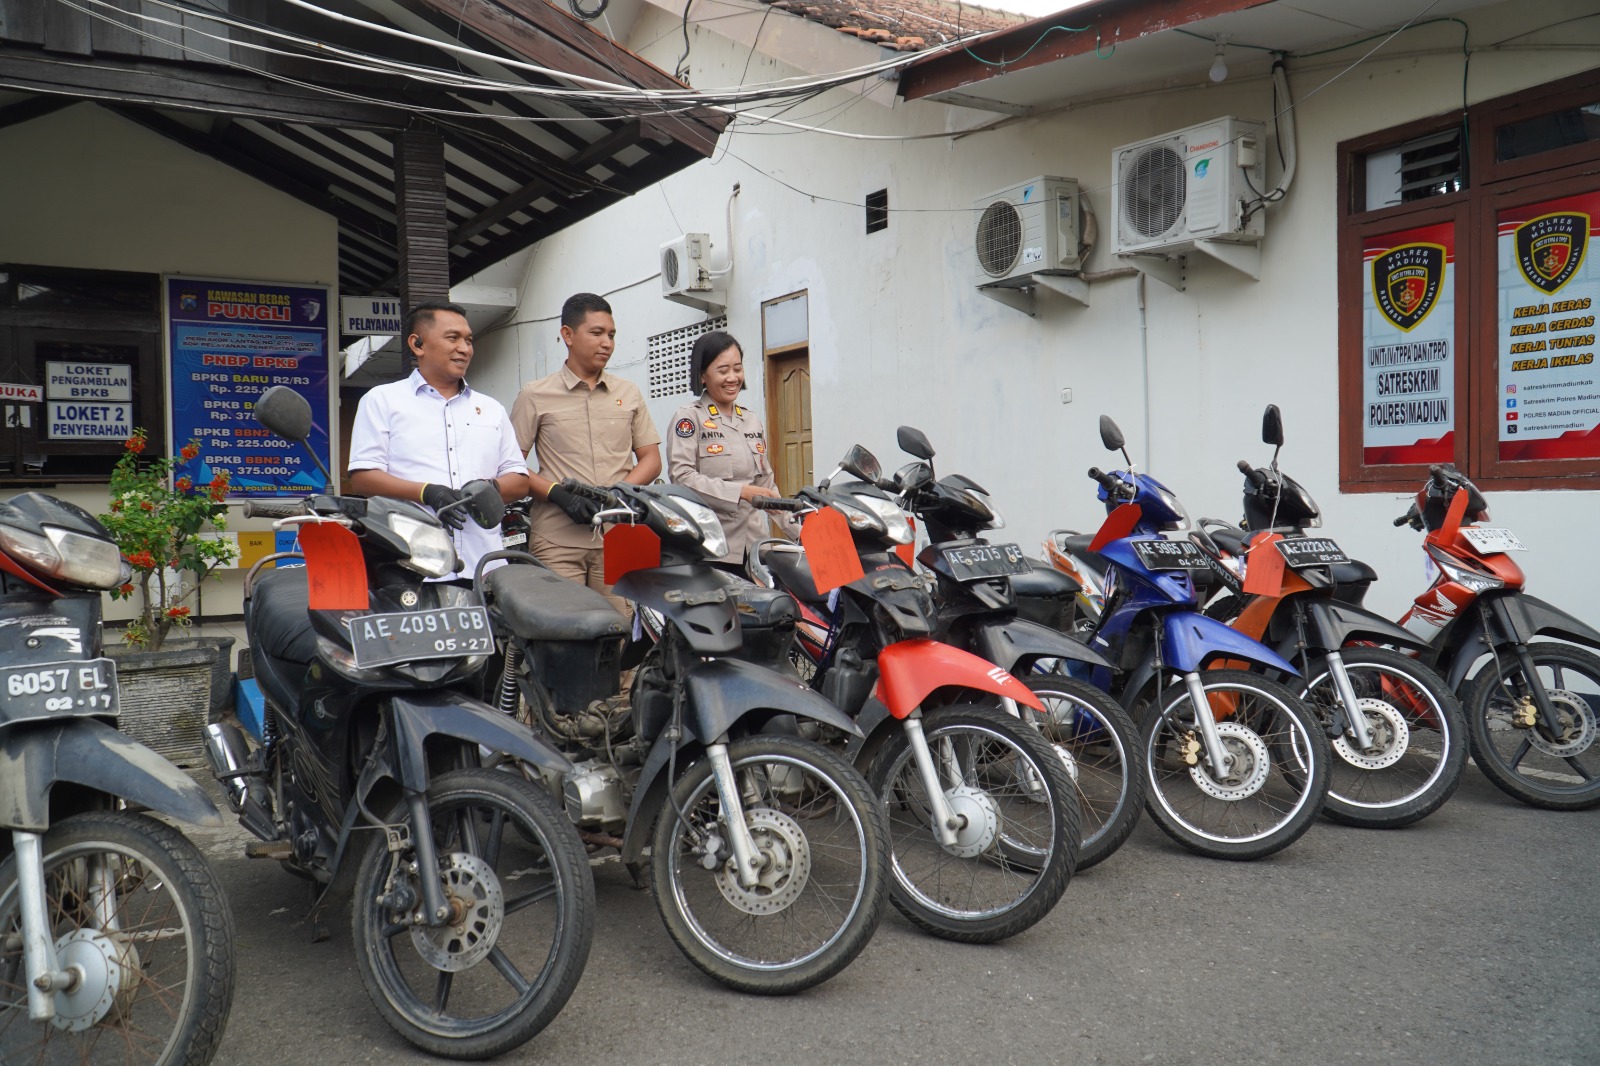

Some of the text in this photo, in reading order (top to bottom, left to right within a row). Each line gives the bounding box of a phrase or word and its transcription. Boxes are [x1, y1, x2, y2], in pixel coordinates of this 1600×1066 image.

[1532, 218, 1572, 231] POLRES
[1532, 226, 1572, 238] MADIUN
[1388, 250, 1428, 263] POLRES
[1388, 257, 1428, 270] MADIUN
[1557, 247, 1580, 283] KRIMINAL
[208, 290, 290, 305] KAWASAN BEBAS
[1413, 281, 1435, 319] KRIMINAL
[208, 302, 291, 321] PUNGLI
[372, 302, 400, 315] UNI
[1513, 298, 1591, 318] KERJA KERAS
[349, 318, 400, 331] PELAYANAN
[1510, 316, 1595, 336] KERJA CERDAS
[1510, 334, 1595, 354] KERJA TUNTAS
[1370, 341, 1447, 366] UNIT IV TPPA DAN TPPO
[203, 354, 298, 368] PNBP BPKB
[1512, 353, 1594, 372] KERJA IKHLAS
[66, 366, 112, 375] LOKET
[51, 376, 127, 386] PENGAMBILAN
[192, 372, 310, 385] BPKB BARU R2/R3
[1378, 369, 1438, 395] SATRESKRIM
[210, 385, 231, 394] Rp.
[1524, 380, 1593, 391] satreskrimmadiunkab
[71, 388, 109, 397] BPKB
[204, 401, 240, 409] BPKB
[57, 406, 124, 421] LOKET 2
[210, 411, 232, 421] Rp.
[1370, 400, 1446, 425] POLRES MADIUN
[53, 424, 128, 436] PENYERAHAN
[194, 428, 230, 436] BPKB
[234, 428, 270, 437] BBN2
[1524, 422, 1584, 431] satreskrimmadiun
[701, 431, 724, 439] ANITA
[212, 439, 295, 449] Rp. 225.000,-
[206, 456, 241, 464] BPKB
[285, 457, 301, 465] R4
[237, 466, 295, 476] 375.000,-
[1138, 542, 1155, 554] AE
[1156, 543, 1182, 555] 5965
[1283, 542, 1300, 554] AE
[1300, 541, 1325, 552] 2223
[949, 551, 965, 564] AE
[970, 548, 1001, 562] 5215
[1204, 554, 1240, 590] HONDA
[364, 618, 392, 641] AE
[400, 613, 450, 634] 4091
[8, 667, 108, 696] 6057 EL
